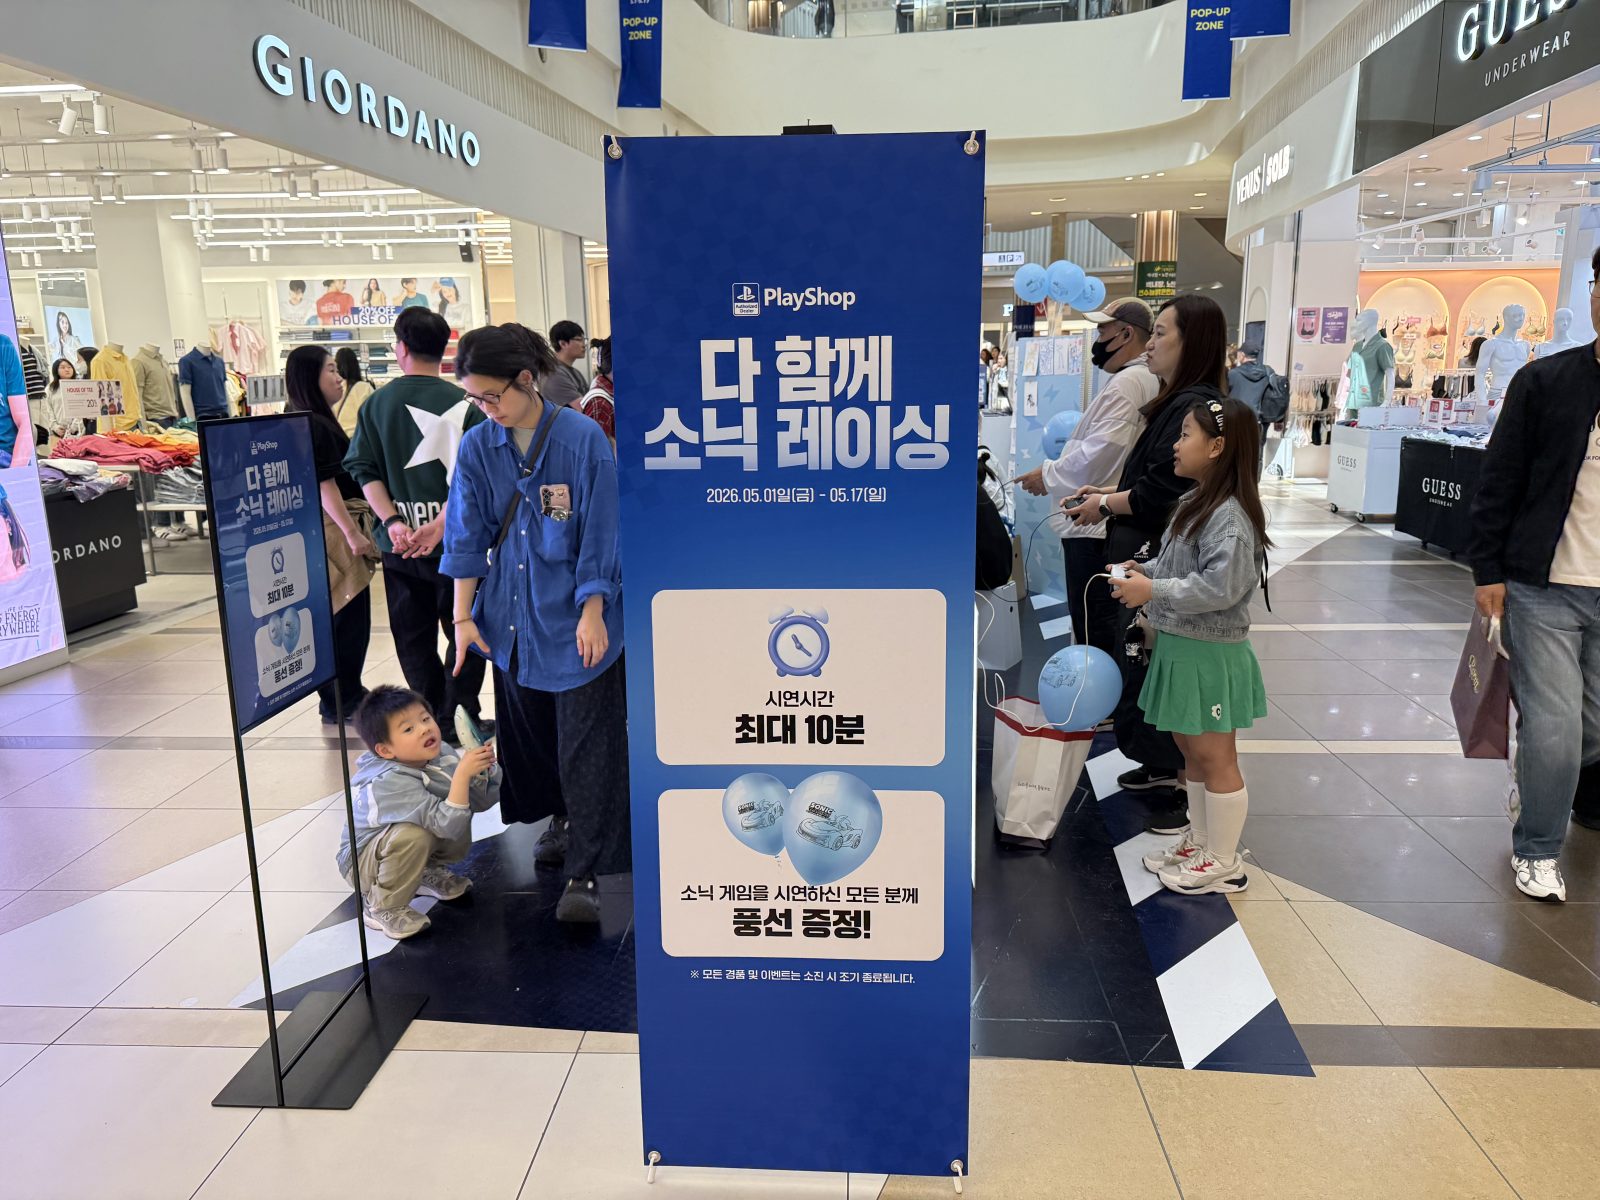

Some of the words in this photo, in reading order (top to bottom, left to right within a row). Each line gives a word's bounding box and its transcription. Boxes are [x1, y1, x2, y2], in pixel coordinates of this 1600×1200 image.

[623, 17, 658, 27] POP-UP
[1190, 7, 1231, 18] POP-UP
[628, 31, 652, 40] ZONE
[1195, 21, 1225, 31] ZONE
[1457, 0, 1568, 61] GUE
[1484, 31, 1571, 87] UNDERWEAR
[253, 34, 481, 167] GIORDANO
[1236, 165, 1261, 205] VENUS
[764, 286, 856, 311] PlayShop
[333, 315, 375, 325] HOUSE
[378, 315, 394, 325] OF
[700, 337, 761, 402] 다
[775, 335, 893, 402] 함께
[257, 441, 278, 451] PlayShop
[644, 407, 758, 471] 소닉
[776, 404, 950, 470] 레이싱
[1337, 455, 1357, 468] GUESS
[245, 465, 261, 491] 다
[263, 460, 289, 488] 함께
[706, 487, 814, 503] 2026.05.01일(금)
[830, 487, 887, 503] 05.17(일)
[1422, 477, 1461, 500] GUESS
[236, 494, 264, 525] 소닉
[266, 485, 303, 516] 레이싱
[5, 607, 40, 624] ENERGY
[765, 690, 835, 707] 시연시간
[735, 714, 796, 744] 최대
[804, 714, 865, 745] 10분
[810, 801, 834, 814] SONIC
[681, 885, 714, 901] 소닉
[719, 885, 769, 901] 게임을
[774, 885, 841, 903] 시연하신
[846, 887, 879, 904] 모든
[885, 887, 919, 904] 분께
[733, 907, 793, 937] 풍선
[801, 909, 871, 939] 증정!
[703, 969, 723, 980] 모든
[725, 970, 745, 980] 경품
[748, 970, 758, 980] 및
[761, 970, 801, 981] 이벤트는
[803, 971, 824, 982] 소진
[826, 972, 837, 982] 시
[839, 972, 860, 982] 조기
[862, 973, 916, 984] 종료됩니다.
